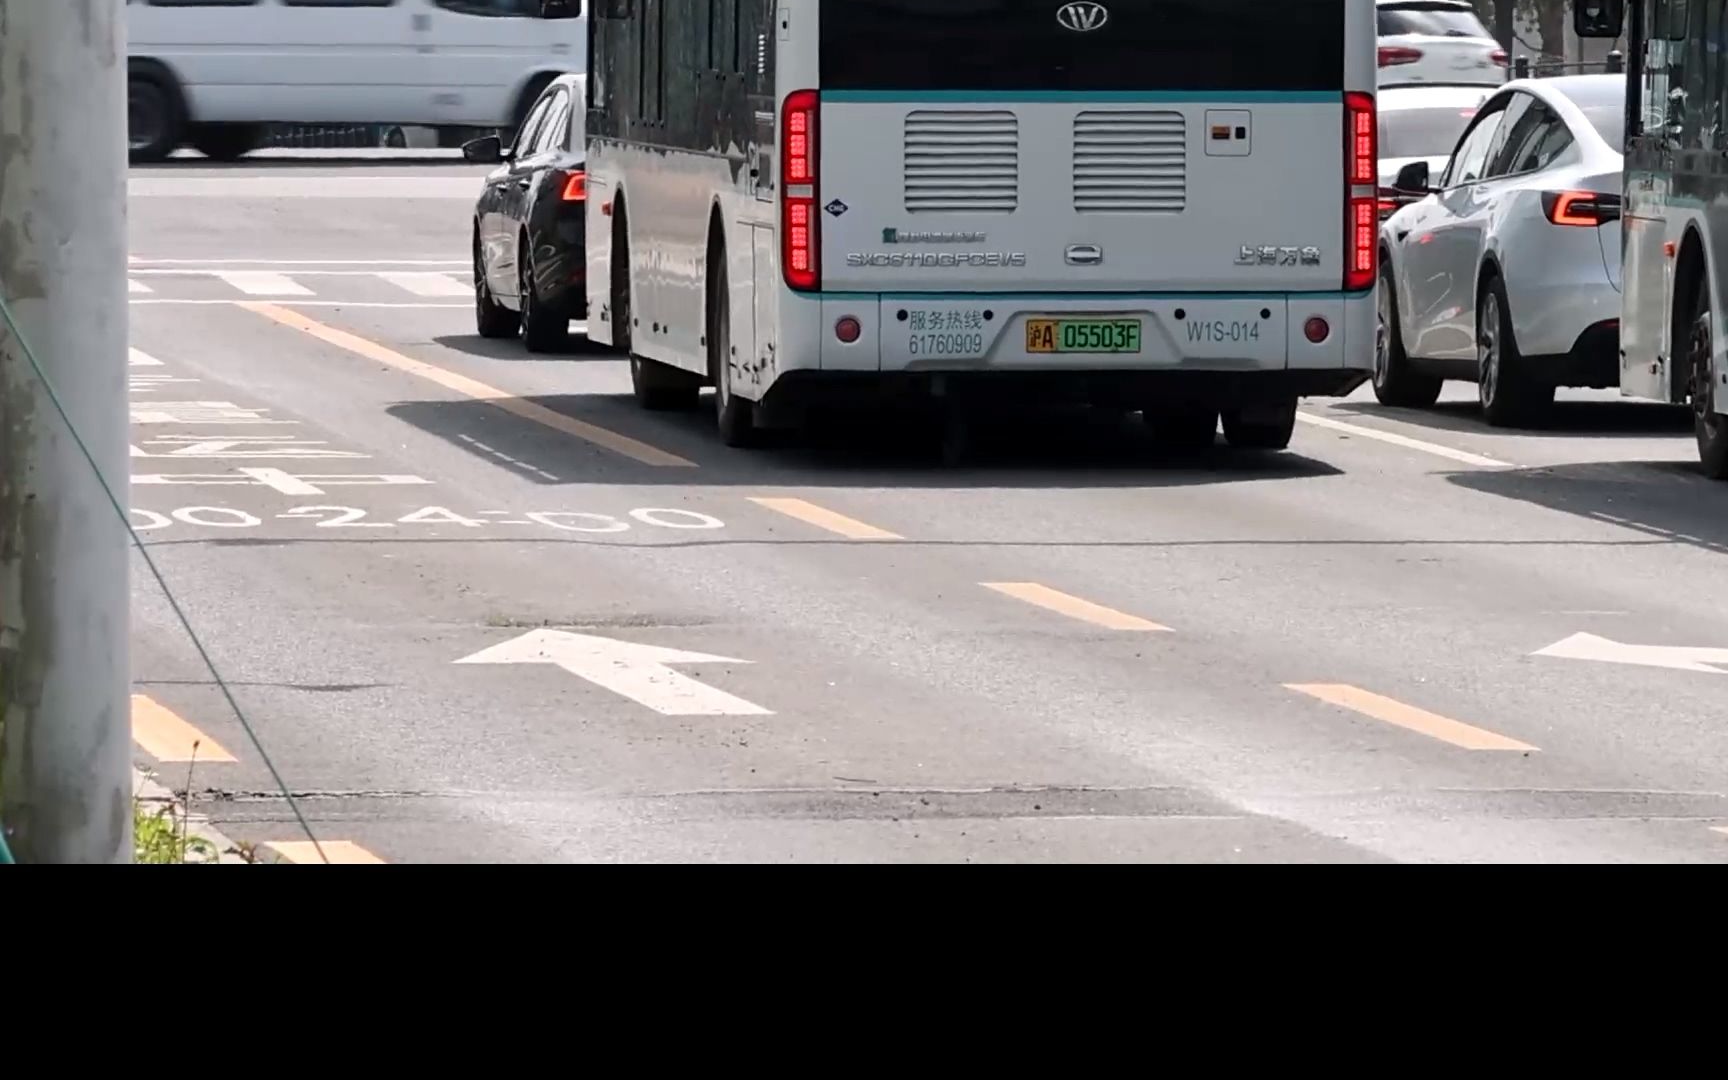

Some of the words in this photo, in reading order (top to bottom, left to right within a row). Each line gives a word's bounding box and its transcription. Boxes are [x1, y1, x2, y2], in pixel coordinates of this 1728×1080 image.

[909, 310, 983, 331] 服务热线
[1186, 320, 1260, 342] W1S-014
[909, 334, 983, 355] 61760909
